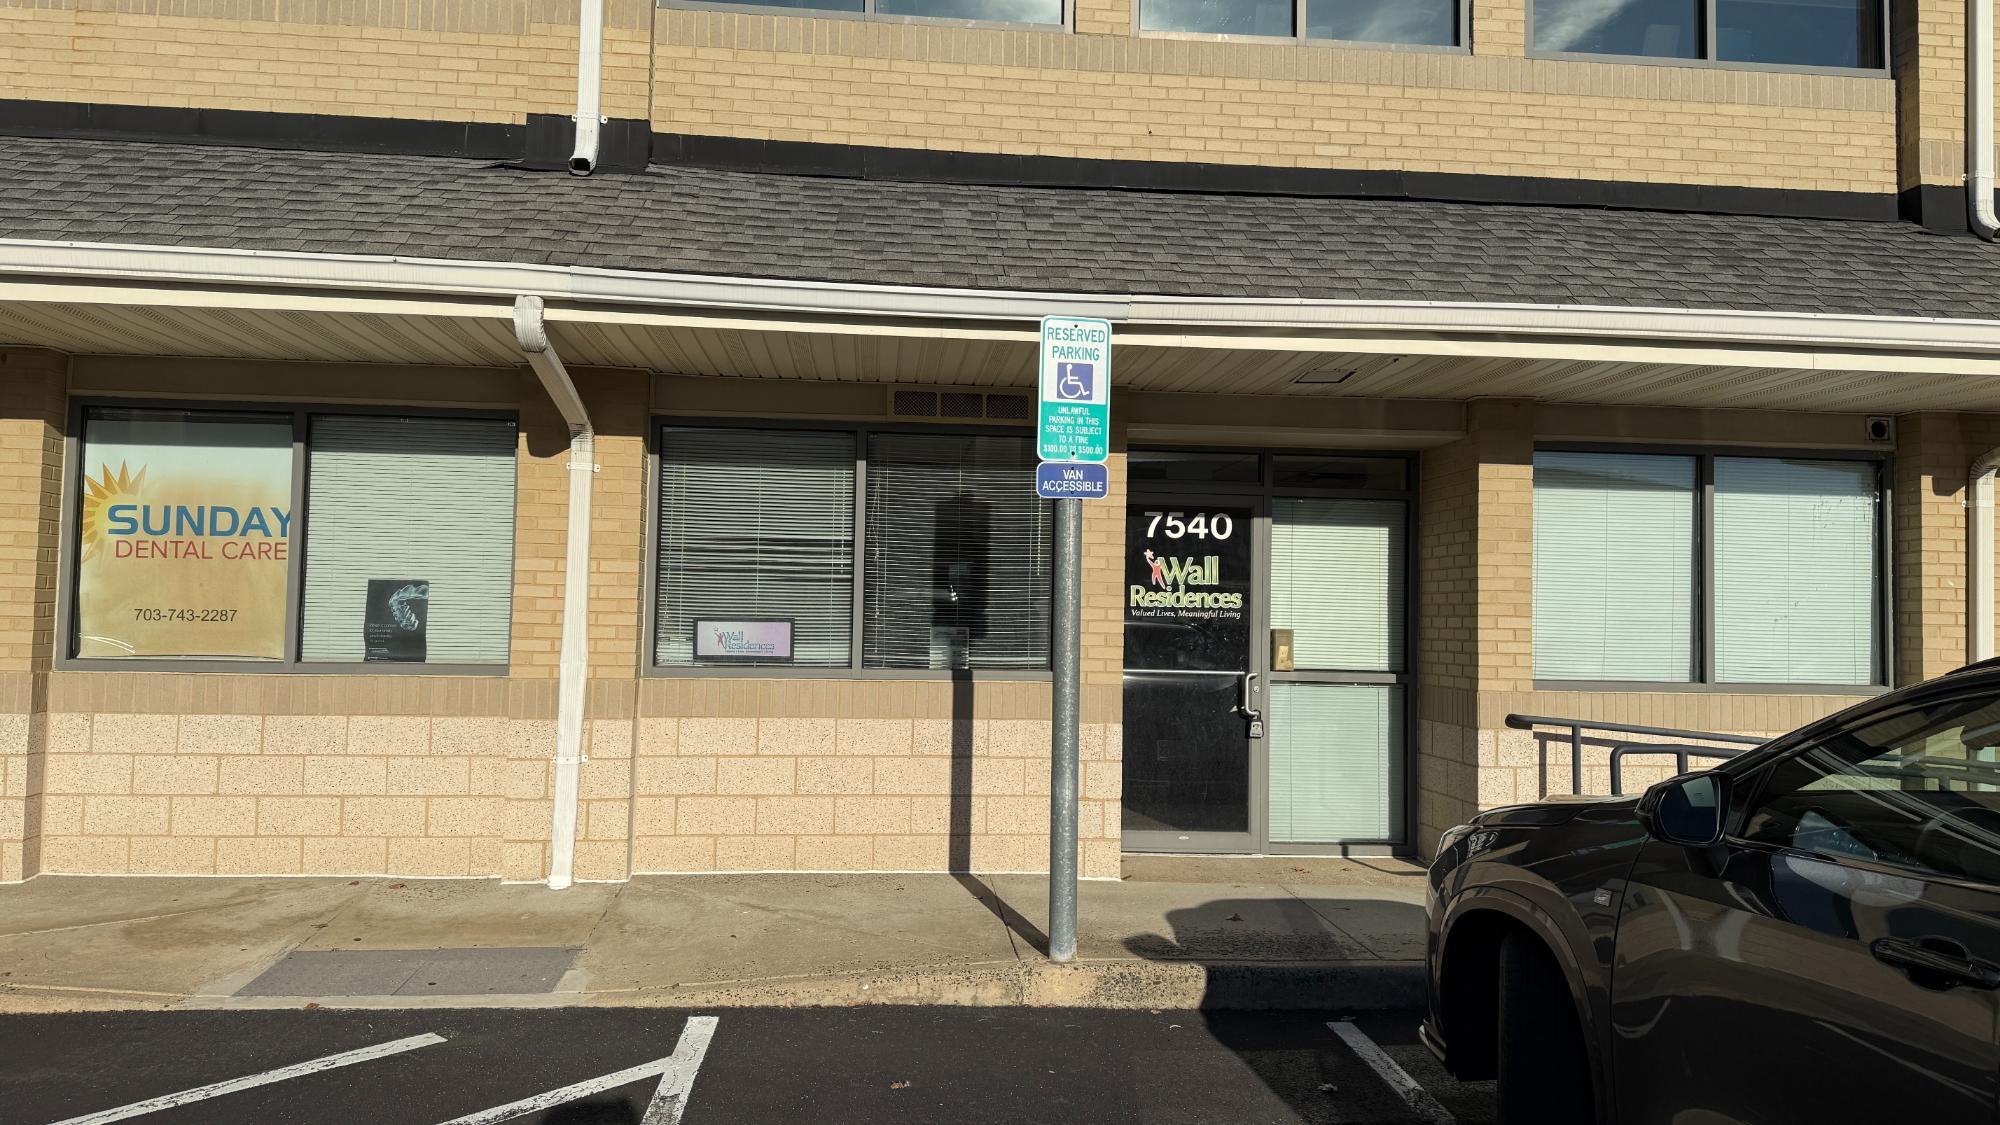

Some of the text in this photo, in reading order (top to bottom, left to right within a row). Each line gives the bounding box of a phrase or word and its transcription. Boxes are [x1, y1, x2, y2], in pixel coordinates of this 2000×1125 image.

[1047, 327, 1106, 343] RESERVED
[1052, 346, 1100, 361] PARKING
[1058, 406, 1091, 416] UNLAWFUL
[1048, 415, 1100, 426] PARKING IN THIS
[1045, 425, 1102, 435] SPACE IS SUBJECT
[1059, 435, 1089, 444] TO A FINE
[1063, 470, 1083, 480] VAN
[1042, 480, 1103, 492] ACCESSIBLE
[108, 504, 291, 538] SUNDAY
[1144, 511, 1233, 540] 7540
[115, 540, 287, 561] DENTAL CARE
[1157, 555, 1219, 585] Wall
[1130, 584, 1243, 609] Residences
[134, 608, 238, 622] 703-743-2287
[1131, 609, 1241, 620] Valued Lives, Meaningful Living
